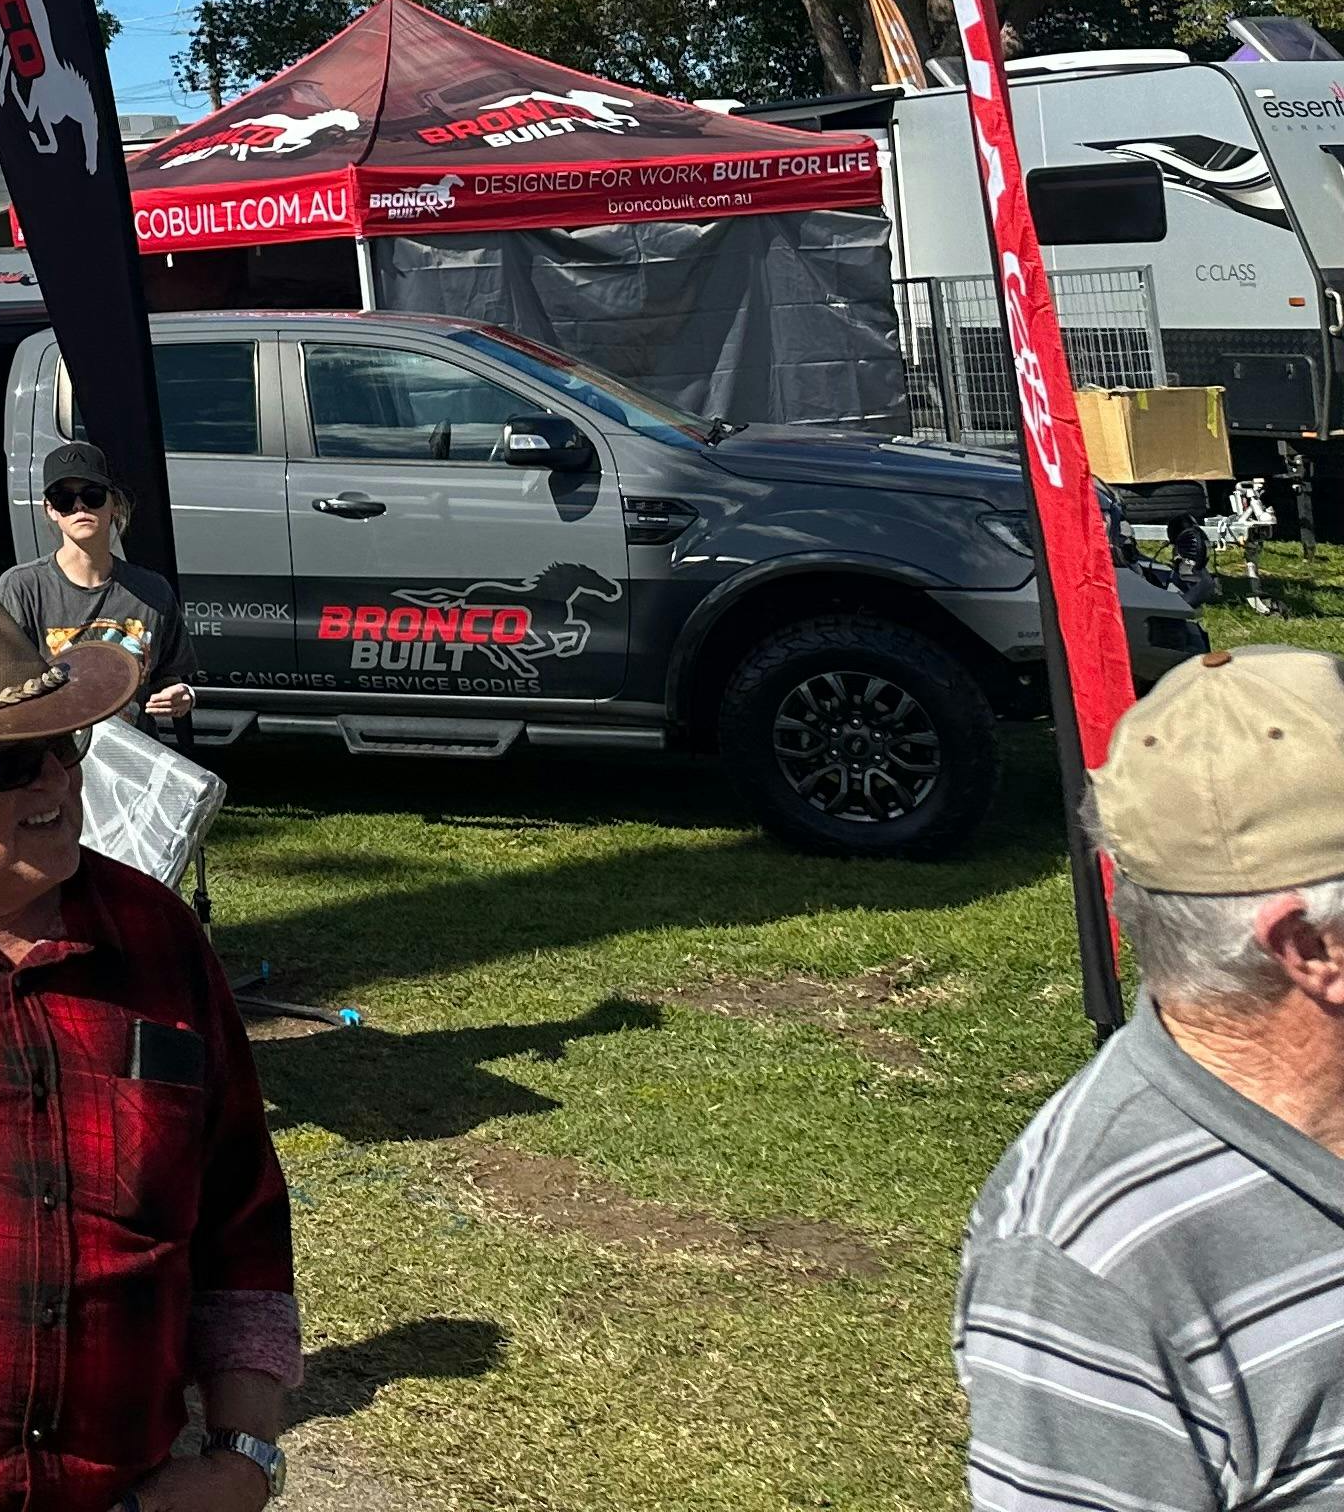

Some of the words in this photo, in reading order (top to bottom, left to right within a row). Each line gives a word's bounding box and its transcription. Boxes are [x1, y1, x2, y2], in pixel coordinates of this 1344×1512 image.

[417, 100, 596, 144] BRONCO
[482, 117, 576, 148] BUILT
[475, 172, 583, 195] DESIGNED
[588, 168, 631, 189] FOR
[639, 164, 707, 186] WORK,
[712, 159, 772, 182] BUILT
[778, 155, 821, 176] FOR
[826, 152, 872, 174] LIFE
[369, 191, 439, 208] BRONCO
[608, 192, 752, 214] broncobuilt.com.au
[134, 188, 347, 239] COBUILT.COM.AU
[387, 206, 424, 220] BUILT
[1209, 263, 1257, 281] CLASS
[184, 601, 224, 618] FOR
[228, 603, 290, 620] WORK
[187, 621, 222, 636] LIFE
[318, 606, 529, 644] BRONCO
[350, 640, 475, 672] BUILT
[229, 671, 337, 687] CANOPIES
[358, 675, 449, 691] SERVICE
[457, 678, 542, 694] BODIES
